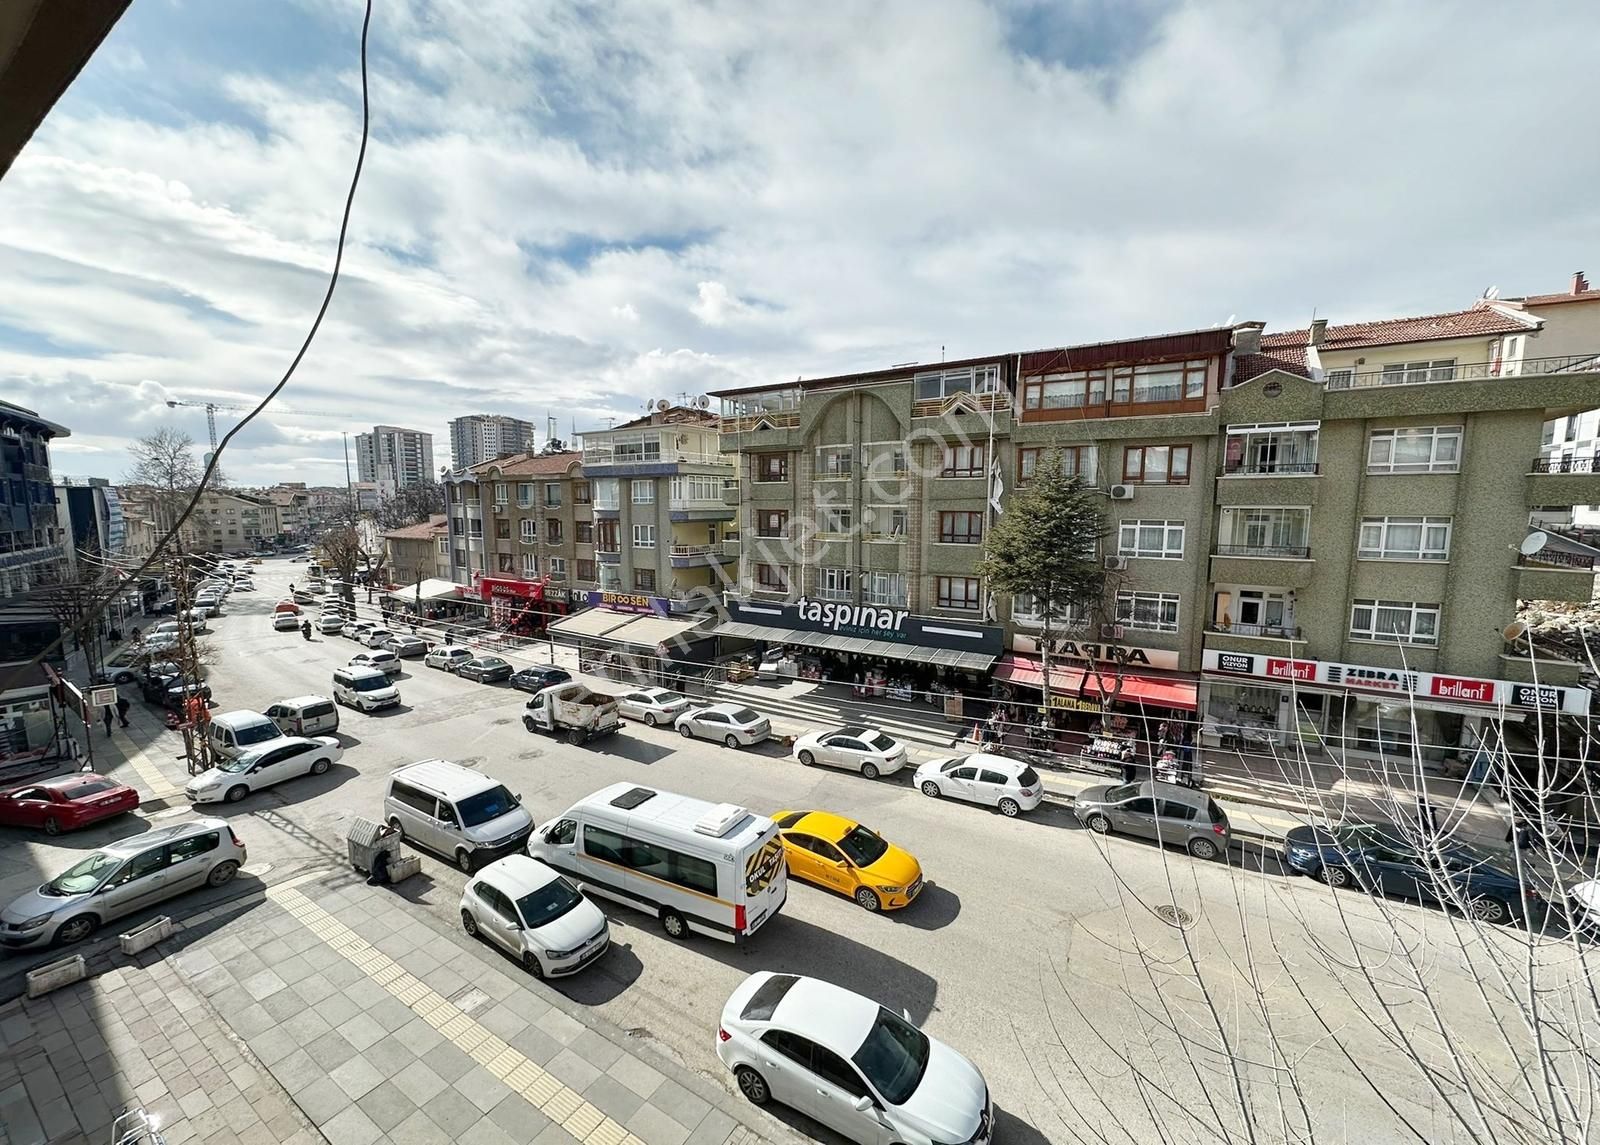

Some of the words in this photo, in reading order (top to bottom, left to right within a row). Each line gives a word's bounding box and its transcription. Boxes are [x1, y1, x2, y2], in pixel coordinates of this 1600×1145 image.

[1222, 655, 1248, 664] ONUR
[1272, 661, 1310, 678] brillant
[1346, 668, 1399, 682] ZEBRA
[1345, 677, 1399, 690] MARKET
[1439, 680, 1486, 699] brillant
[750, 866, 766, 883] OKUL
